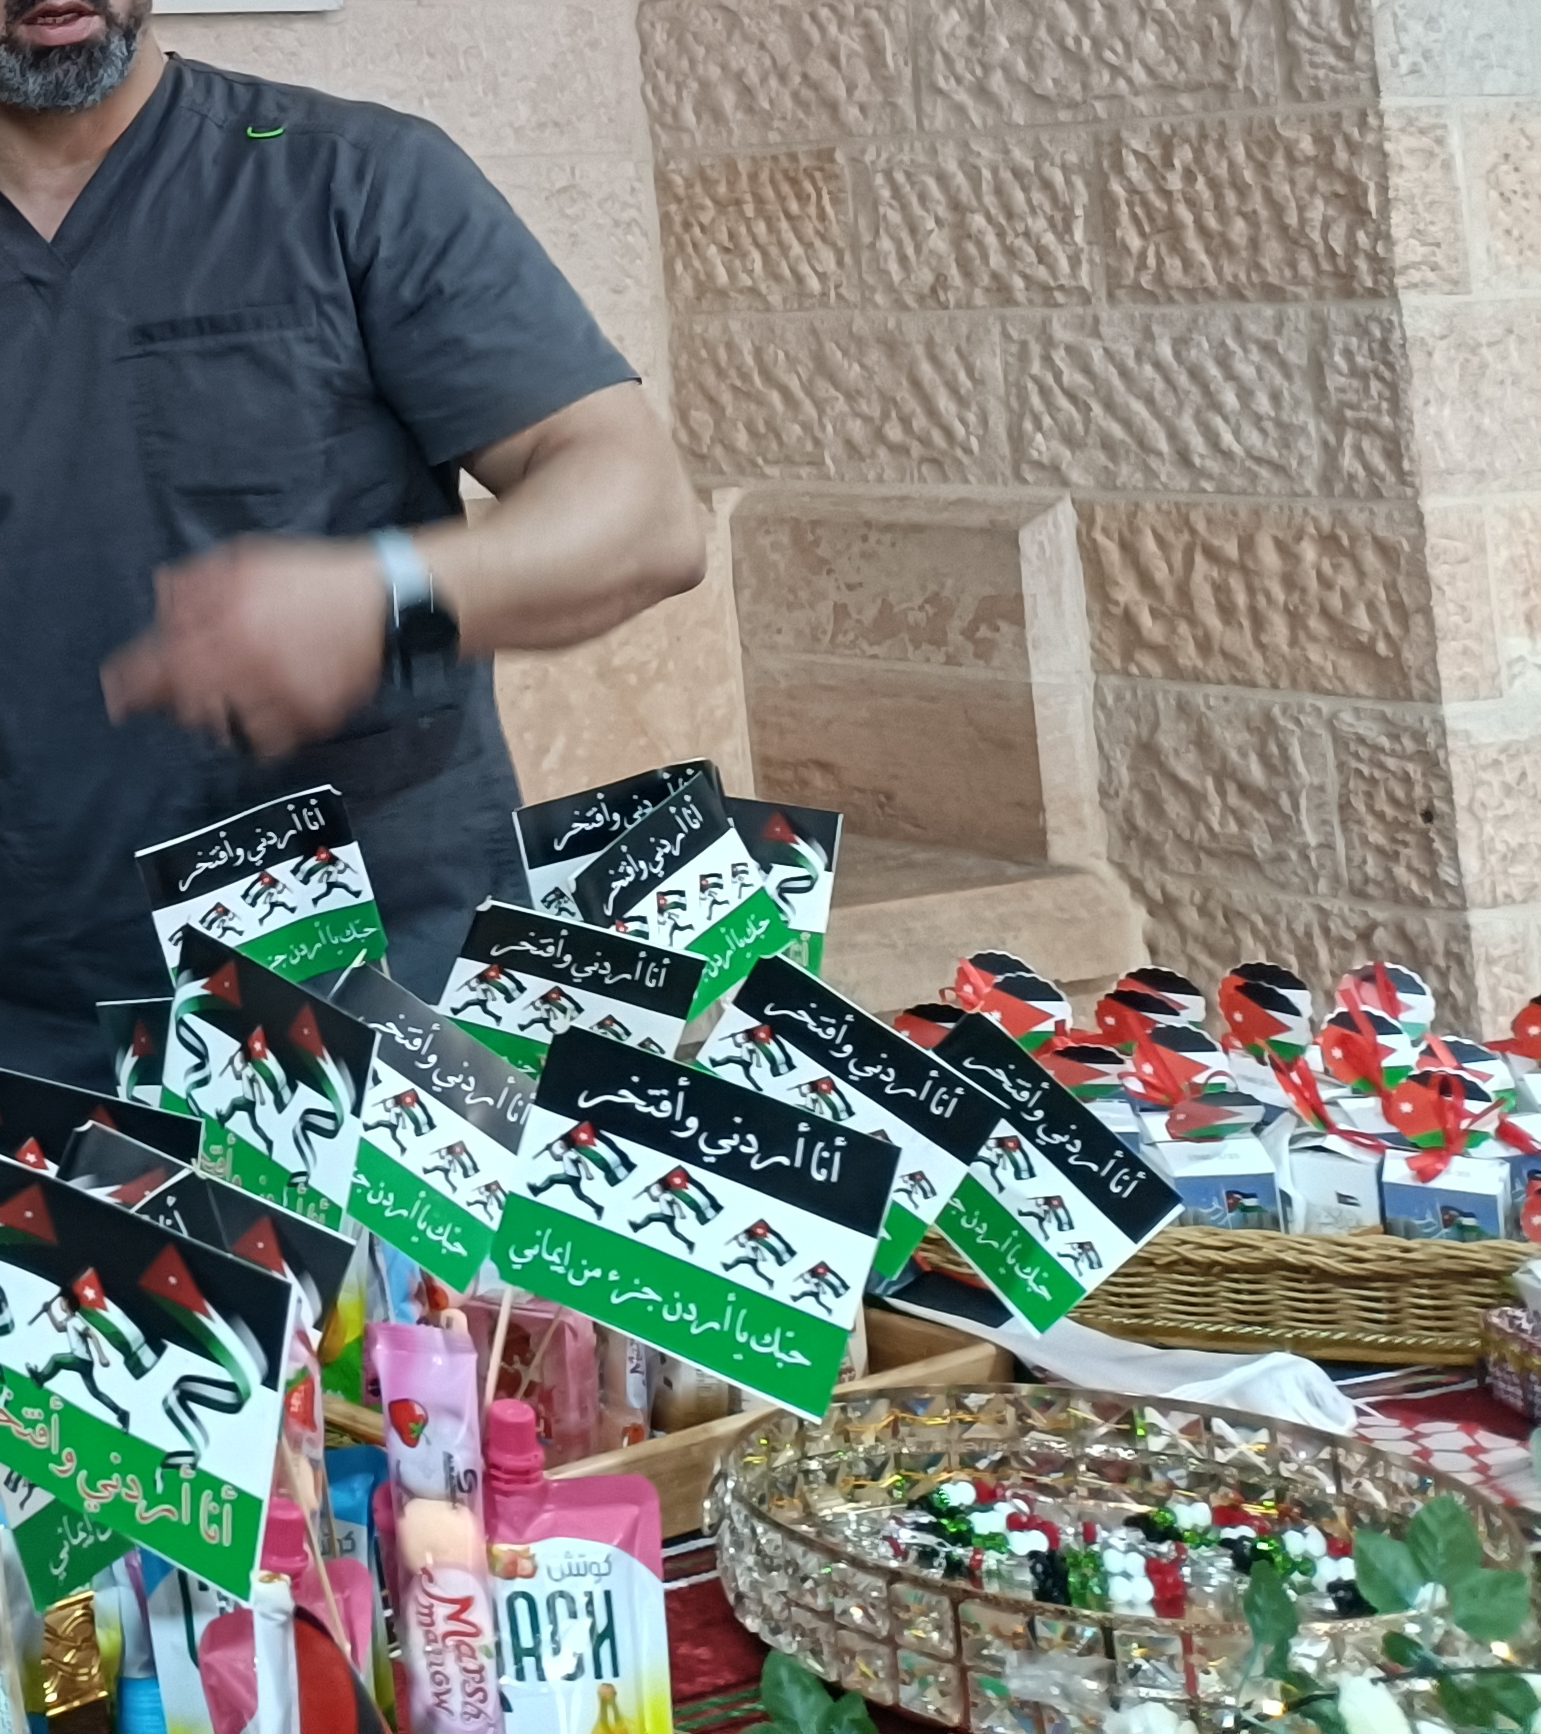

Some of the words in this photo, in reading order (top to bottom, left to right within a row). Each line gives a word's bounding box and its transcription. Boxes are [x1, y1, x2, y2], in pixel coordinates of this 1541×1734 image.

[246, 803, 303, 867] أردني
[302, 798, 326, 831] أنا
[554, 791, 621, 852] وأفتخر
[683, 794, 704, 828] أنا
[178, 830, 245, 893] وأفتخر
[649, 806, 689, 878] أردني
[603, 844, 650, 917] وأفتخر
[288, 921, 327, 965] أردن
[489, 928, 573, 969] وأفتخر
[570, 951, 648, 984] أردني
[645, 957, 670, 989] أنا
[762, 1000, 855, 1059] وأفتخر
[430, 1061, 517, 1109] أردني
[847, 1051, 937, 1102] أردني
[961, 1052, 1050, 1125] وأفتخر
[576, 1074, 700, 1139] وأفتخر
[928, 1086, 966, 1119] أنا
[697, 1115, 812, 1172] أردني
[810, 1136, 848, 1183] أنا
[1035, 1122, 1125, 1177] أردني
[366, 1180, 427, 1221] أردن
[1107, 1168, 1147, 1199] أنا
[507, 1227, 573, 1276] إيماني
[959, 1209, 1019, 1253] أردن
[566, 1257, 604, 1287] من
[608, 1269, 664, 1313] جزء
[661, 1290, 739, 1336] أردن
[731, 1307, 750, 1361] يا
[75, 1451, 198, 1526] أردني
[198, 1483, 239, 1547] أنا
[545, 1550, 614, 1583] كوتش
[423, 1570, 495, 1725] Marsh
[494, 1588, 621, 1684] ACH
